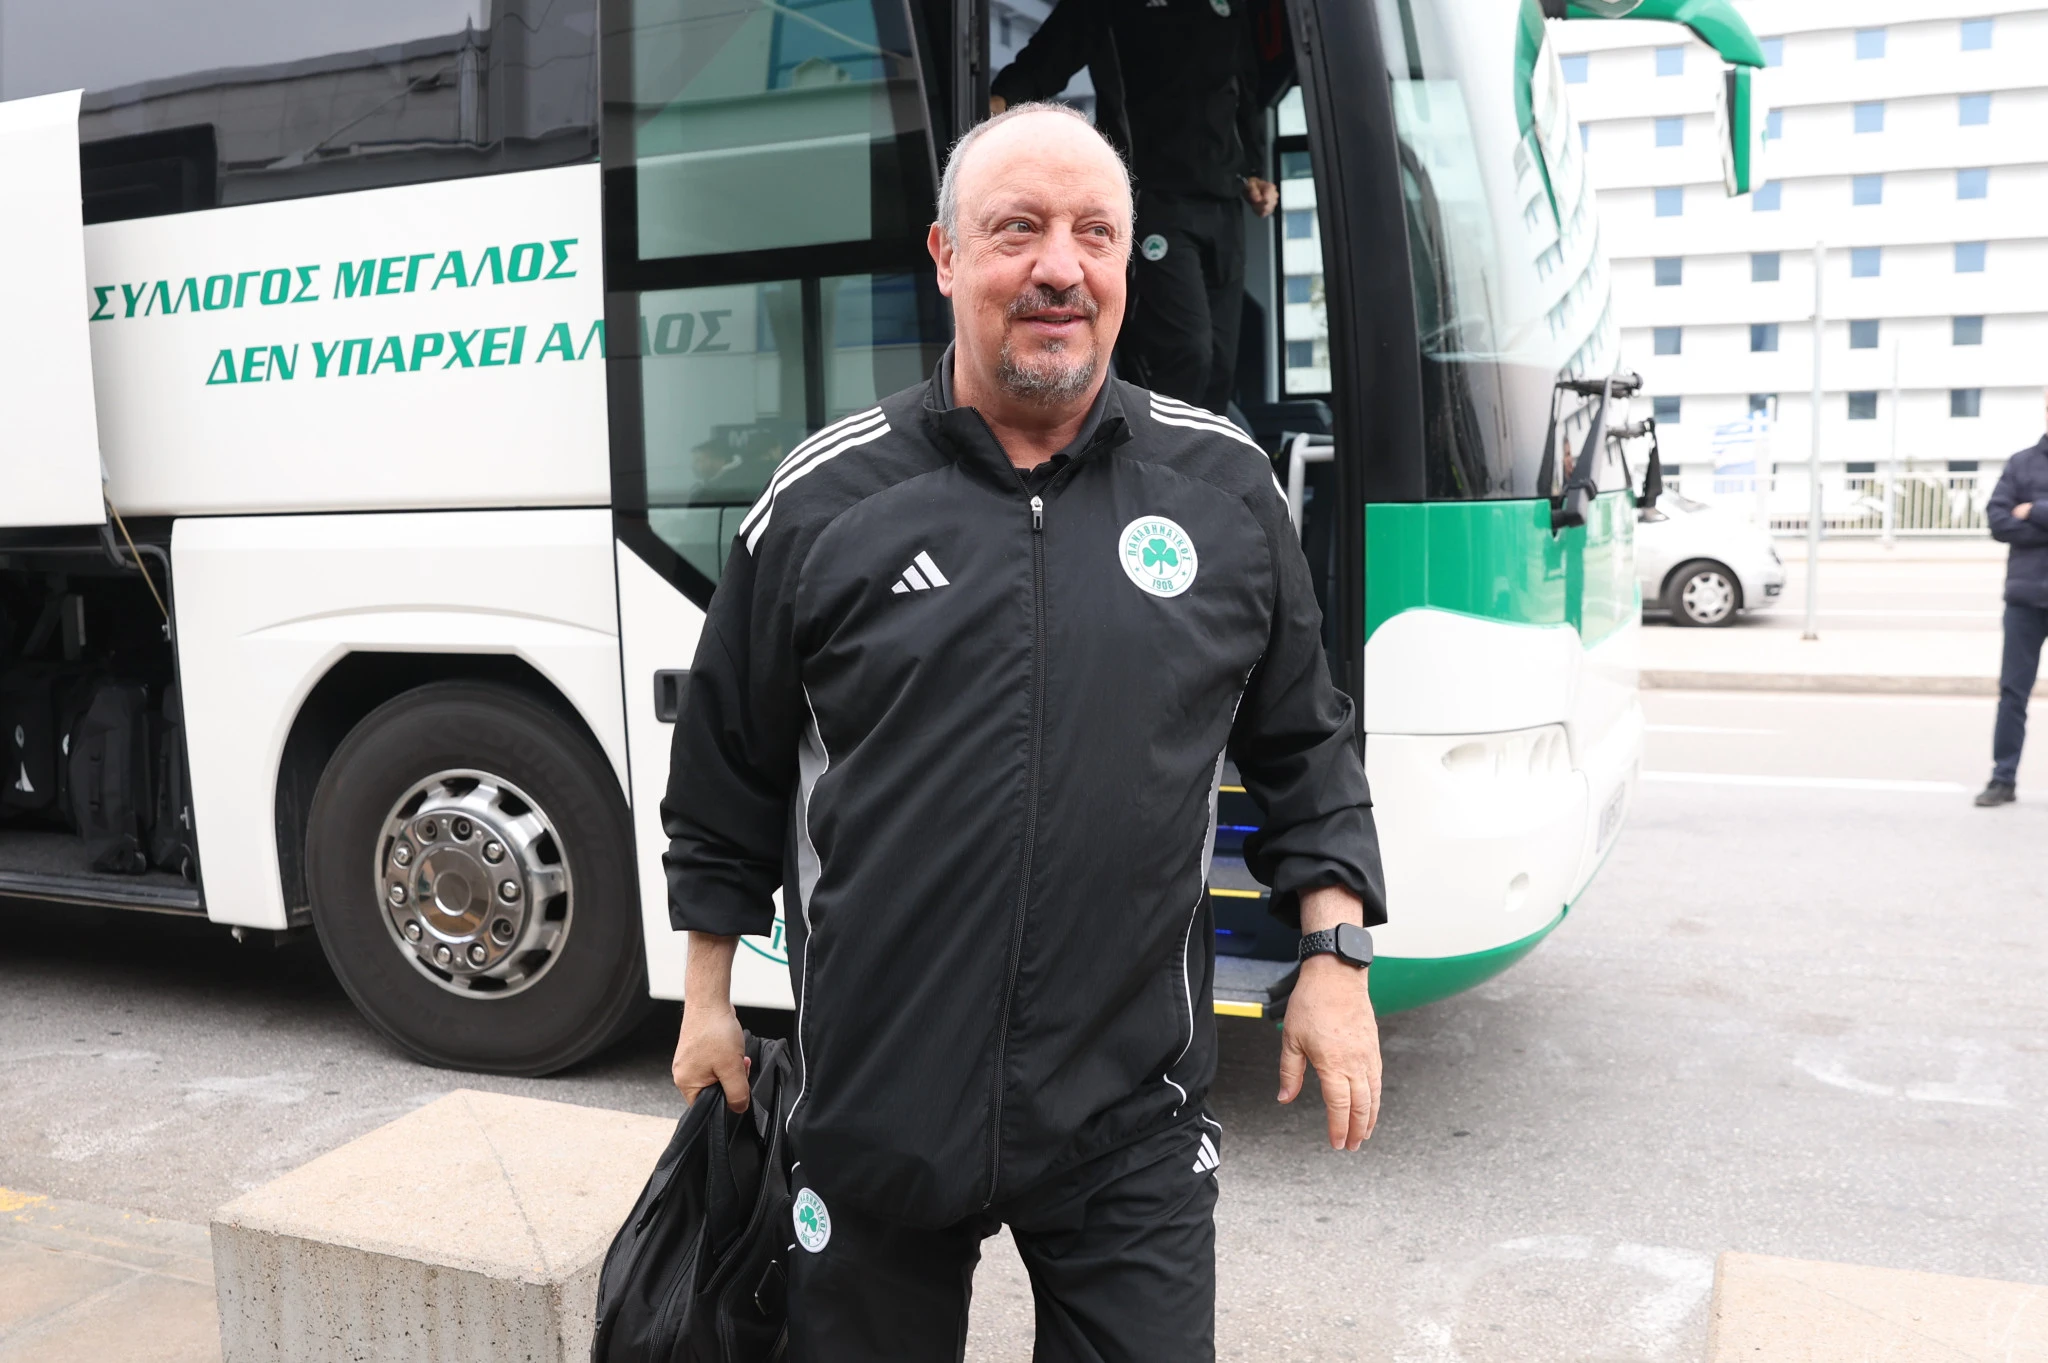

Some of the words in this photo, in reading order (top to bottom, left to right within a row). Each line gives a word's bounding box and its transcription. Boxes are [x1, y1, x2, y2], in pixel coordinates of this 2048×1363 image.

[89, 265, 321, 322] ΣΥΛΛΟΓΟΣ
[333, 238, 579, 300] ΜΕΓΑΛΟΣ
[205, 343, 299, 385] ΔΕΝ
[311, 325, 527, 378] ΥΠΑΡΧΕΙ
[1152, 578, 1174, 591] 1908
